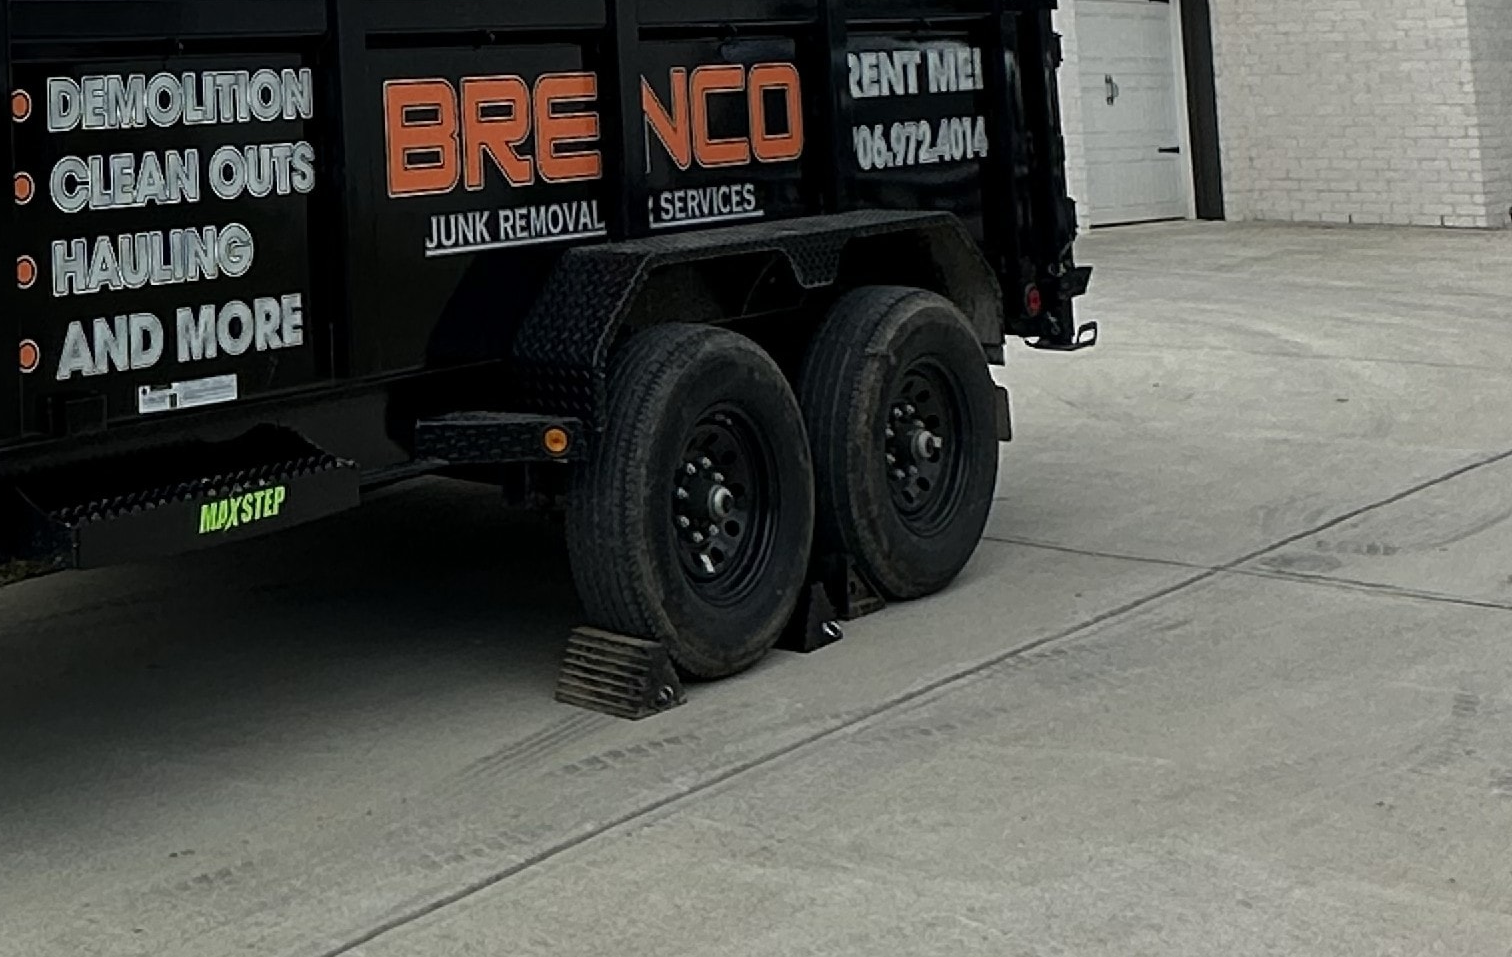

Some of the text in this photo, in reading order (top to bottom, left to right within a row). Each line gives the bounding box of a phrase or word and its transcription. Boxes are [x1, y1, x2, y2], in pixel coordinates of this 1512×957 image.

[47, 69, 314, 133] DEMOLITION
[50, 141, 316, 212] CLEAN OUTS
[425, 209, 491, 248] JUNK
[498, 200, 607, 244] REMOVAL
[660, 183, 756, 221] SERVICES
[52, 223, 254, 297] HAULING
[55, 294, 305, 381] AND MORE
